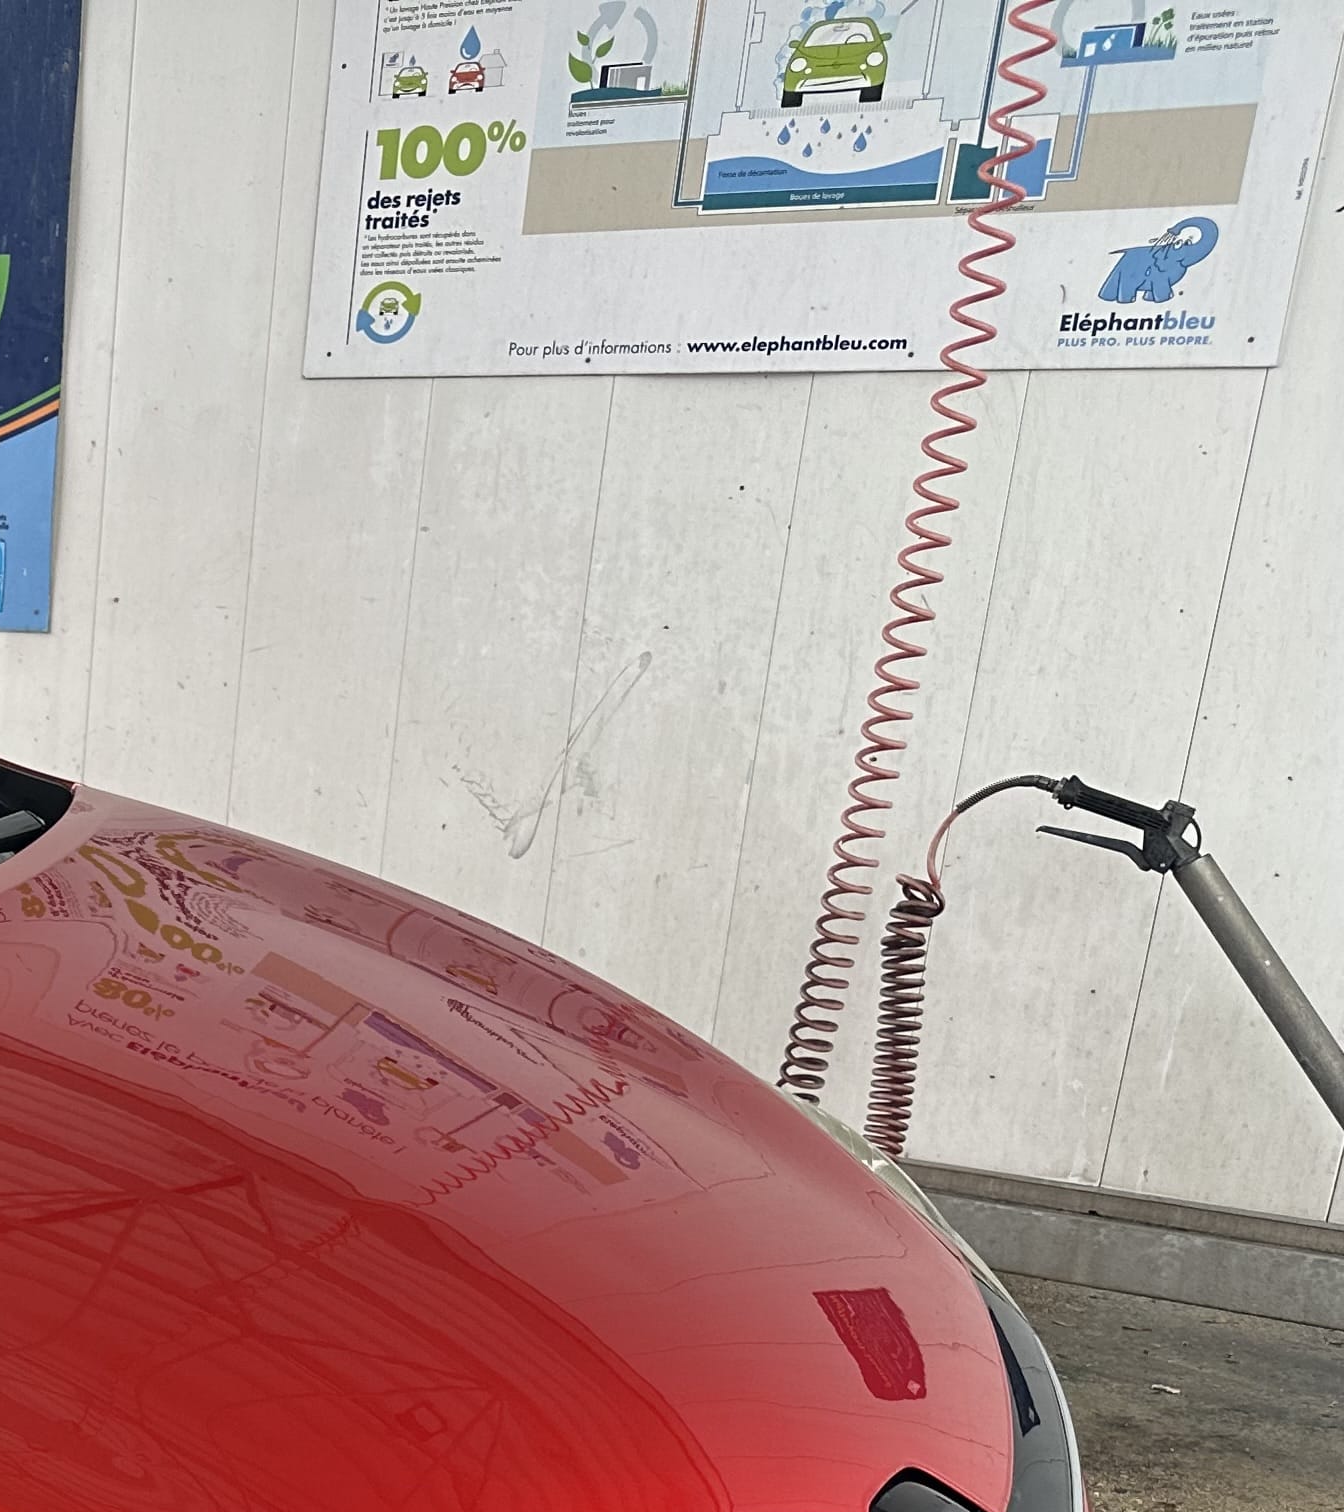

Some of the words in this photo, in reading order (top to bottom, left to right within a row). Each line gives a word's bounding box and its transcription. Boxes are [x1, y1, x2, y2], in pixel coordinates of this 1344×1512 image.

[376, 119, 527, 180] 100%
[368, 190, 401, 209] des
[406, 188, 461, 211] rejets
[365, 210, 430, 230] traités
[1059, 310, 1216, 336] Eléphantbleu
[509, 341, 538, 356] Pour
[543, 341, 570, 358] plus
[574, 339, 672, 356] d'informations
[687, 334, 908, 354] www.elephantbleu.com
[1057, 336, 1087, 348] PLUS
[1090, 336, 1120, 347] PRO.
[1125, 336, 1156, 346] PLUS
[1159, 335, 1213, 346] PROPRE.
